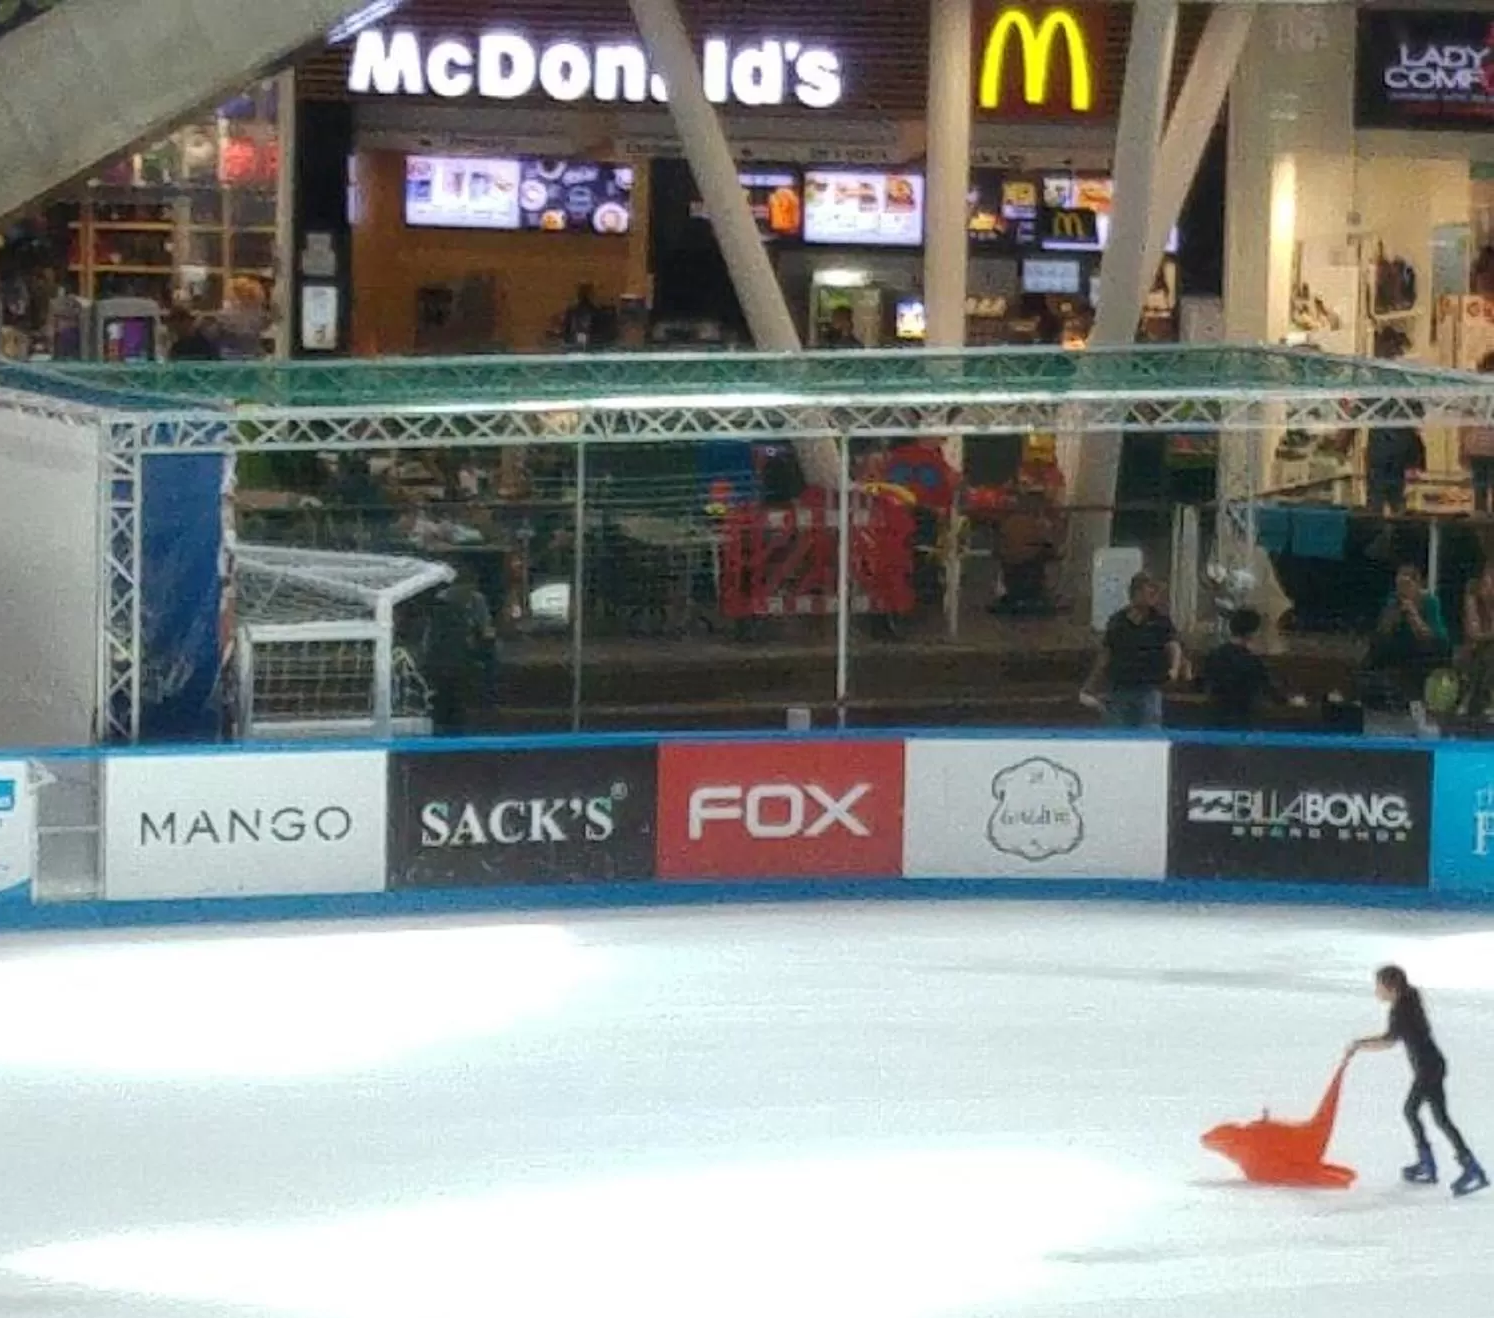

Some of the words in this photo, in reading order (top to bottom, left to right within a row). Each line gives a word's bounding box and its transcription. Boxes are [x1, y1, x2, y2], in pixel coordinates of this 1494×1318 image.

[348, 29, 842, 108] McDonld's
[1399, 44, 1490, 68] LADY
[140, 806, 353, 846] MANGO
[420, 795, 614, 847] SACK'S
[686, 783, 872, 840] FOX
[1233, 788, 1414, 829] BILLABONG
